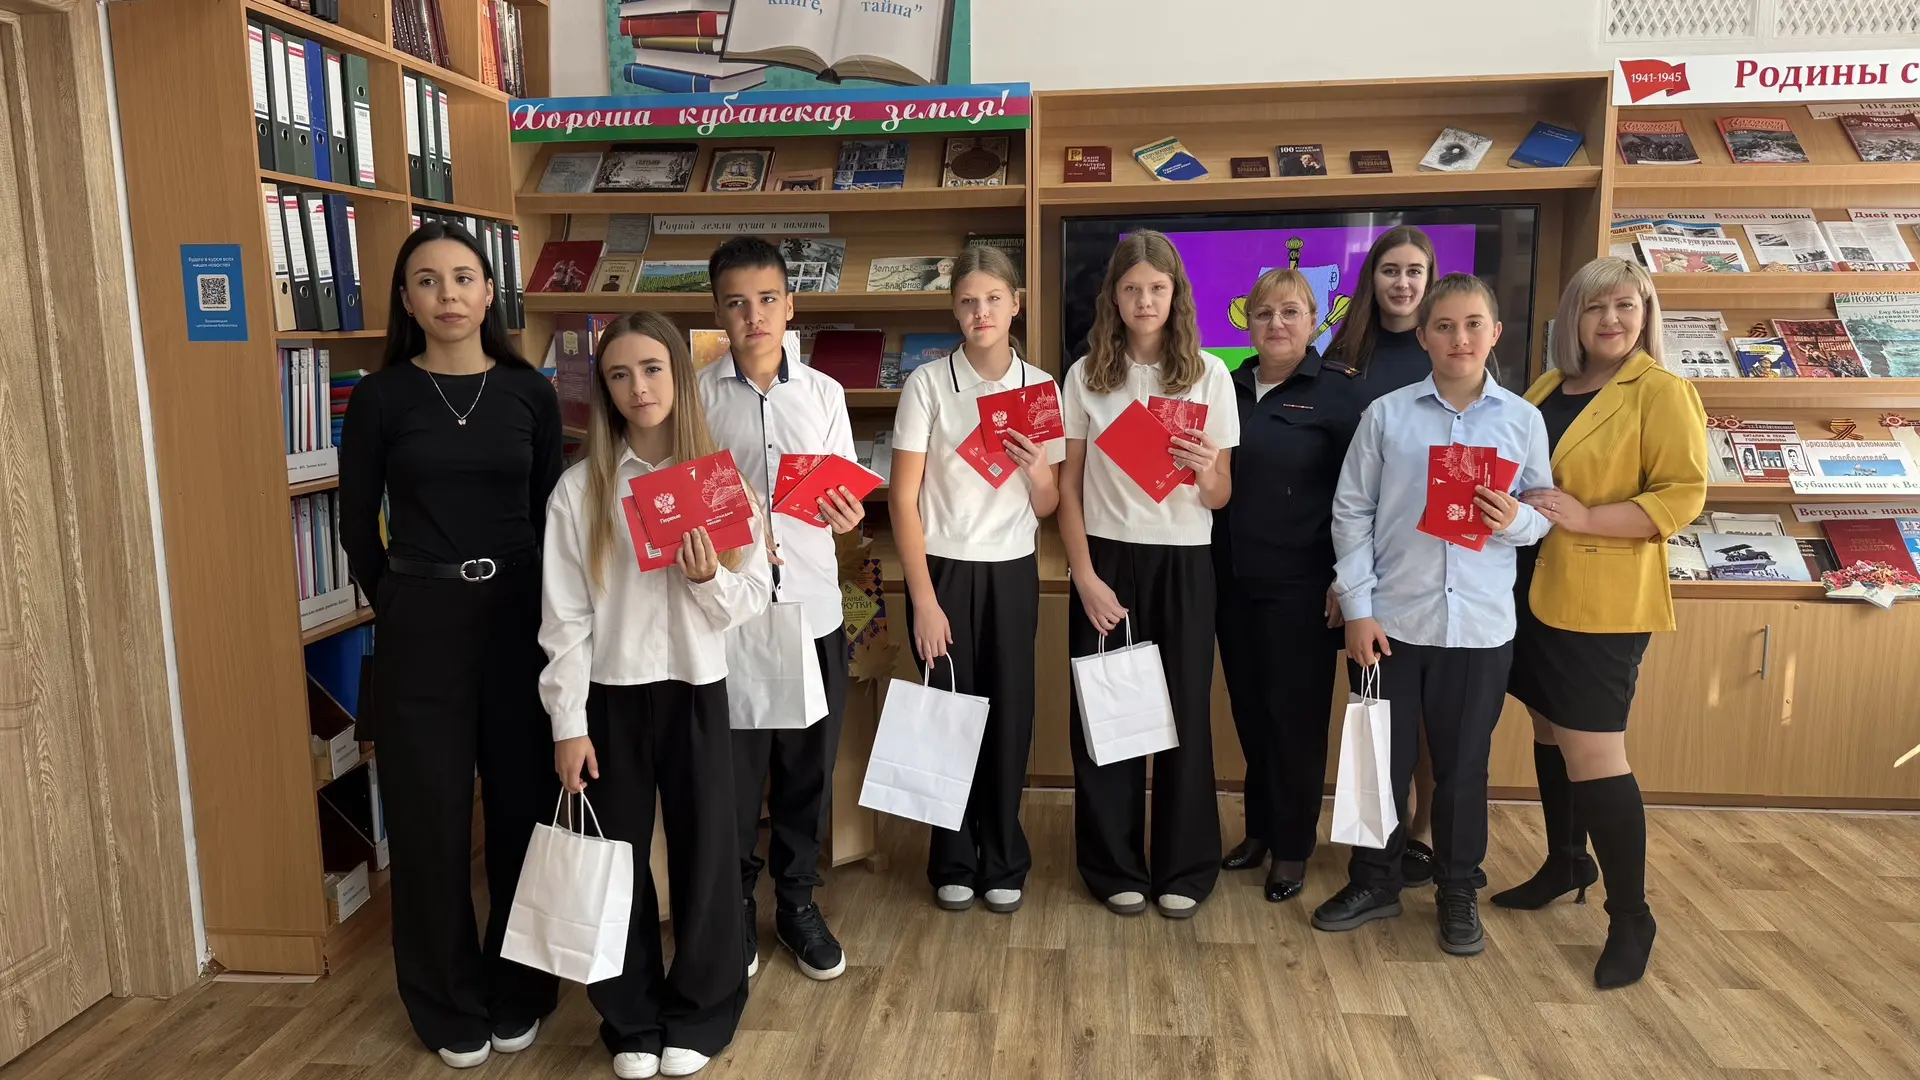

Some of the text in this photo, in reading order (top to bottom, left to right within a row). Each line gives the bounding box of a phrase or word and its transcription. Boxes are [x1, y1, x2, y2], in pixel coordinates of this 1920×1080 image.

[1630, 72, 1682, 83] 1941-1945
[1734, 60, 1889, 93] Родины
[512, 89, 1010, 135] Хороша кубанская земля!
[1715, 211, 1766, 219] Великой
[659, 220, 695, 232] Родной
[701, 222, 731, 230] земли
[737, 222, 764, 232] душа
[1851, 295, 1898, 303] НОВОСТИ
[1794, 480, 1861, 490] Кубанский
[1799, 507, 1868, 518] Ветераны
[1880, 507, 1918, 515] наша
